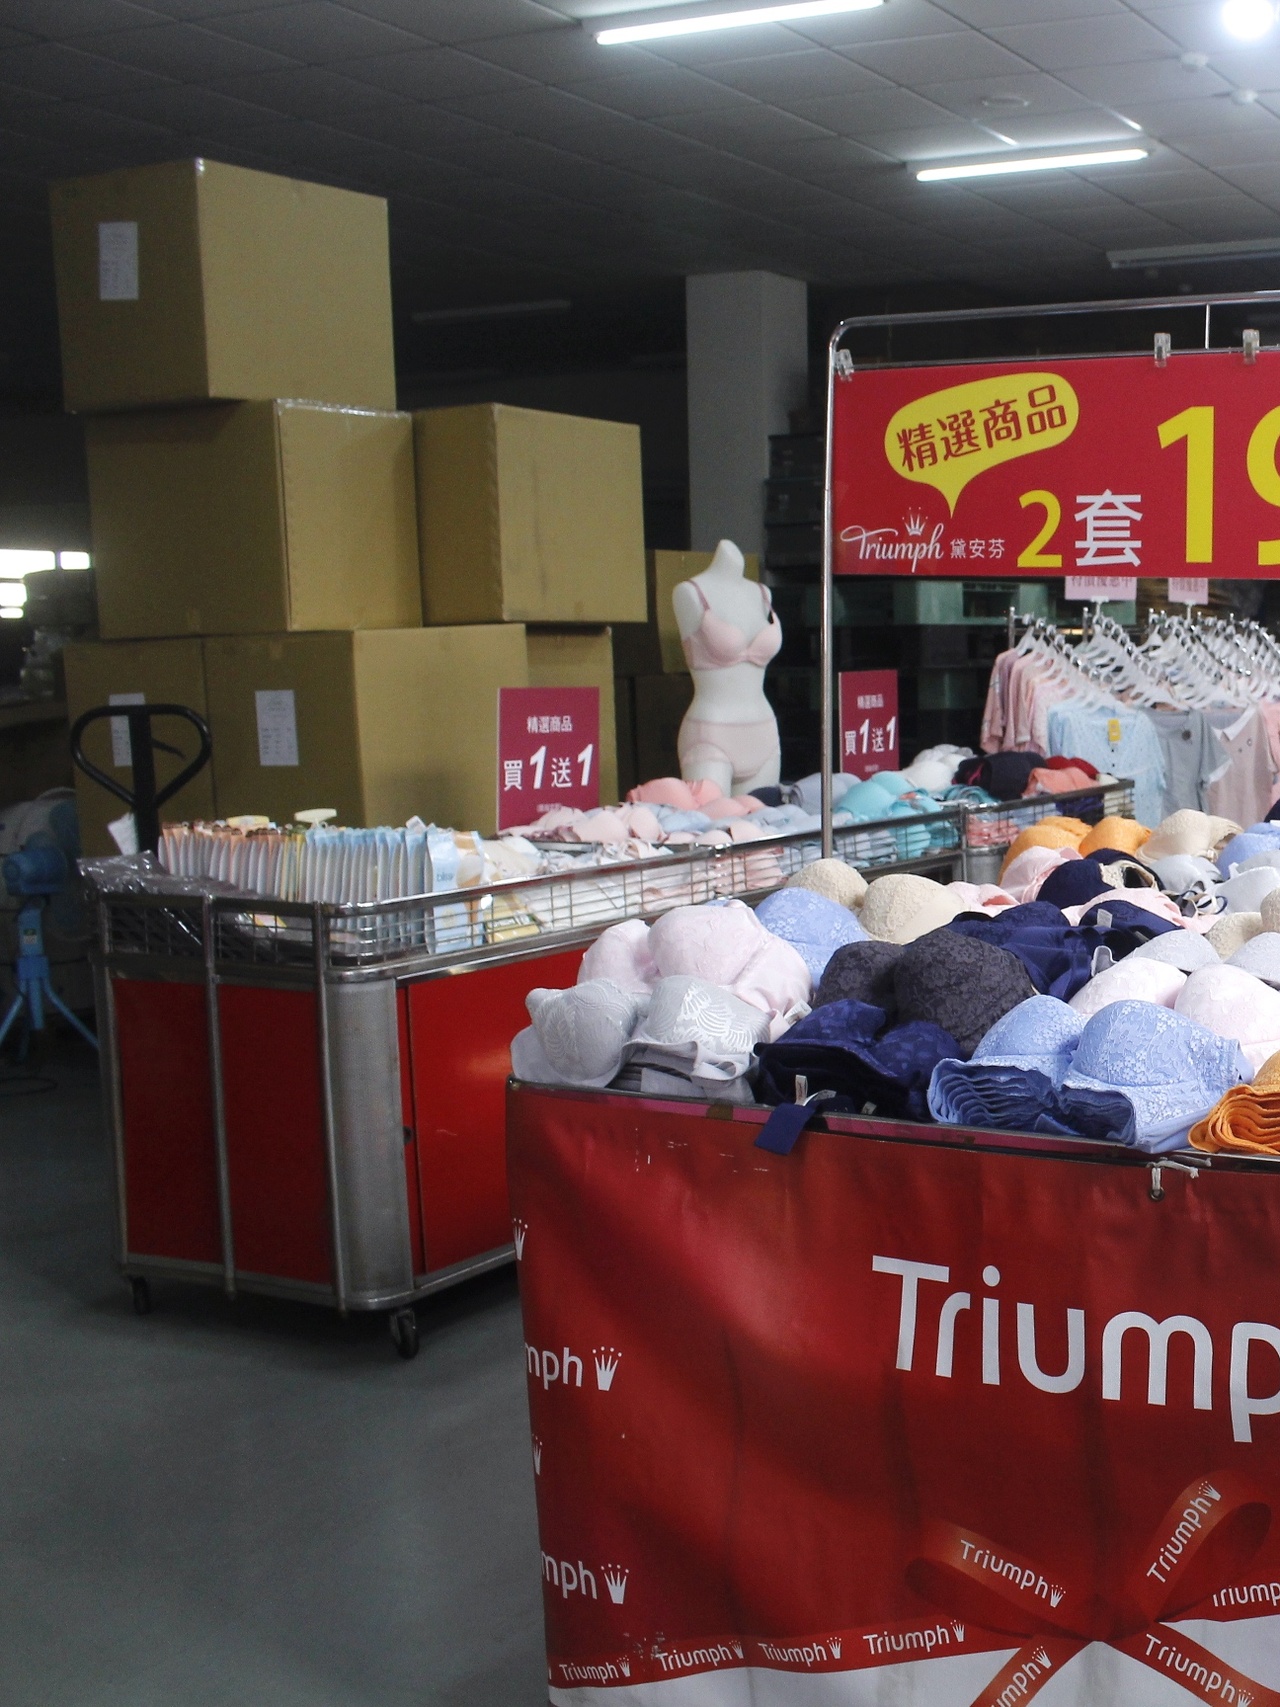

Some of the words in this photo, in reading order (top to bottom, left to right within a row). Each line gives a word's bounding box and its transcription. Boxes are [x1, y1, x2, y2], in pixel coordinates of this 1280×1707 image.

[896, 384, 1067, 472] 精選商品
[840, 523, 944, 573] Triumph
[950, 538, 1005, 559] 黛安芬
[527, 715, 573, 733] 精選商品
[504, 743, 594, 791] 買1送1
[1146, 1495, 1212, 1583] Triumph
[960, 1539, 1049, 1599] Triumph
[657, 1643, 733, 1671] Triumph
[757, 1643, 827, 1667] Triumph
[863, 1624, 950, 1654] Triumph
[559, 1661, 619, 1684] Triumph
[1146, 1634, 1235, 1703] Triumph
